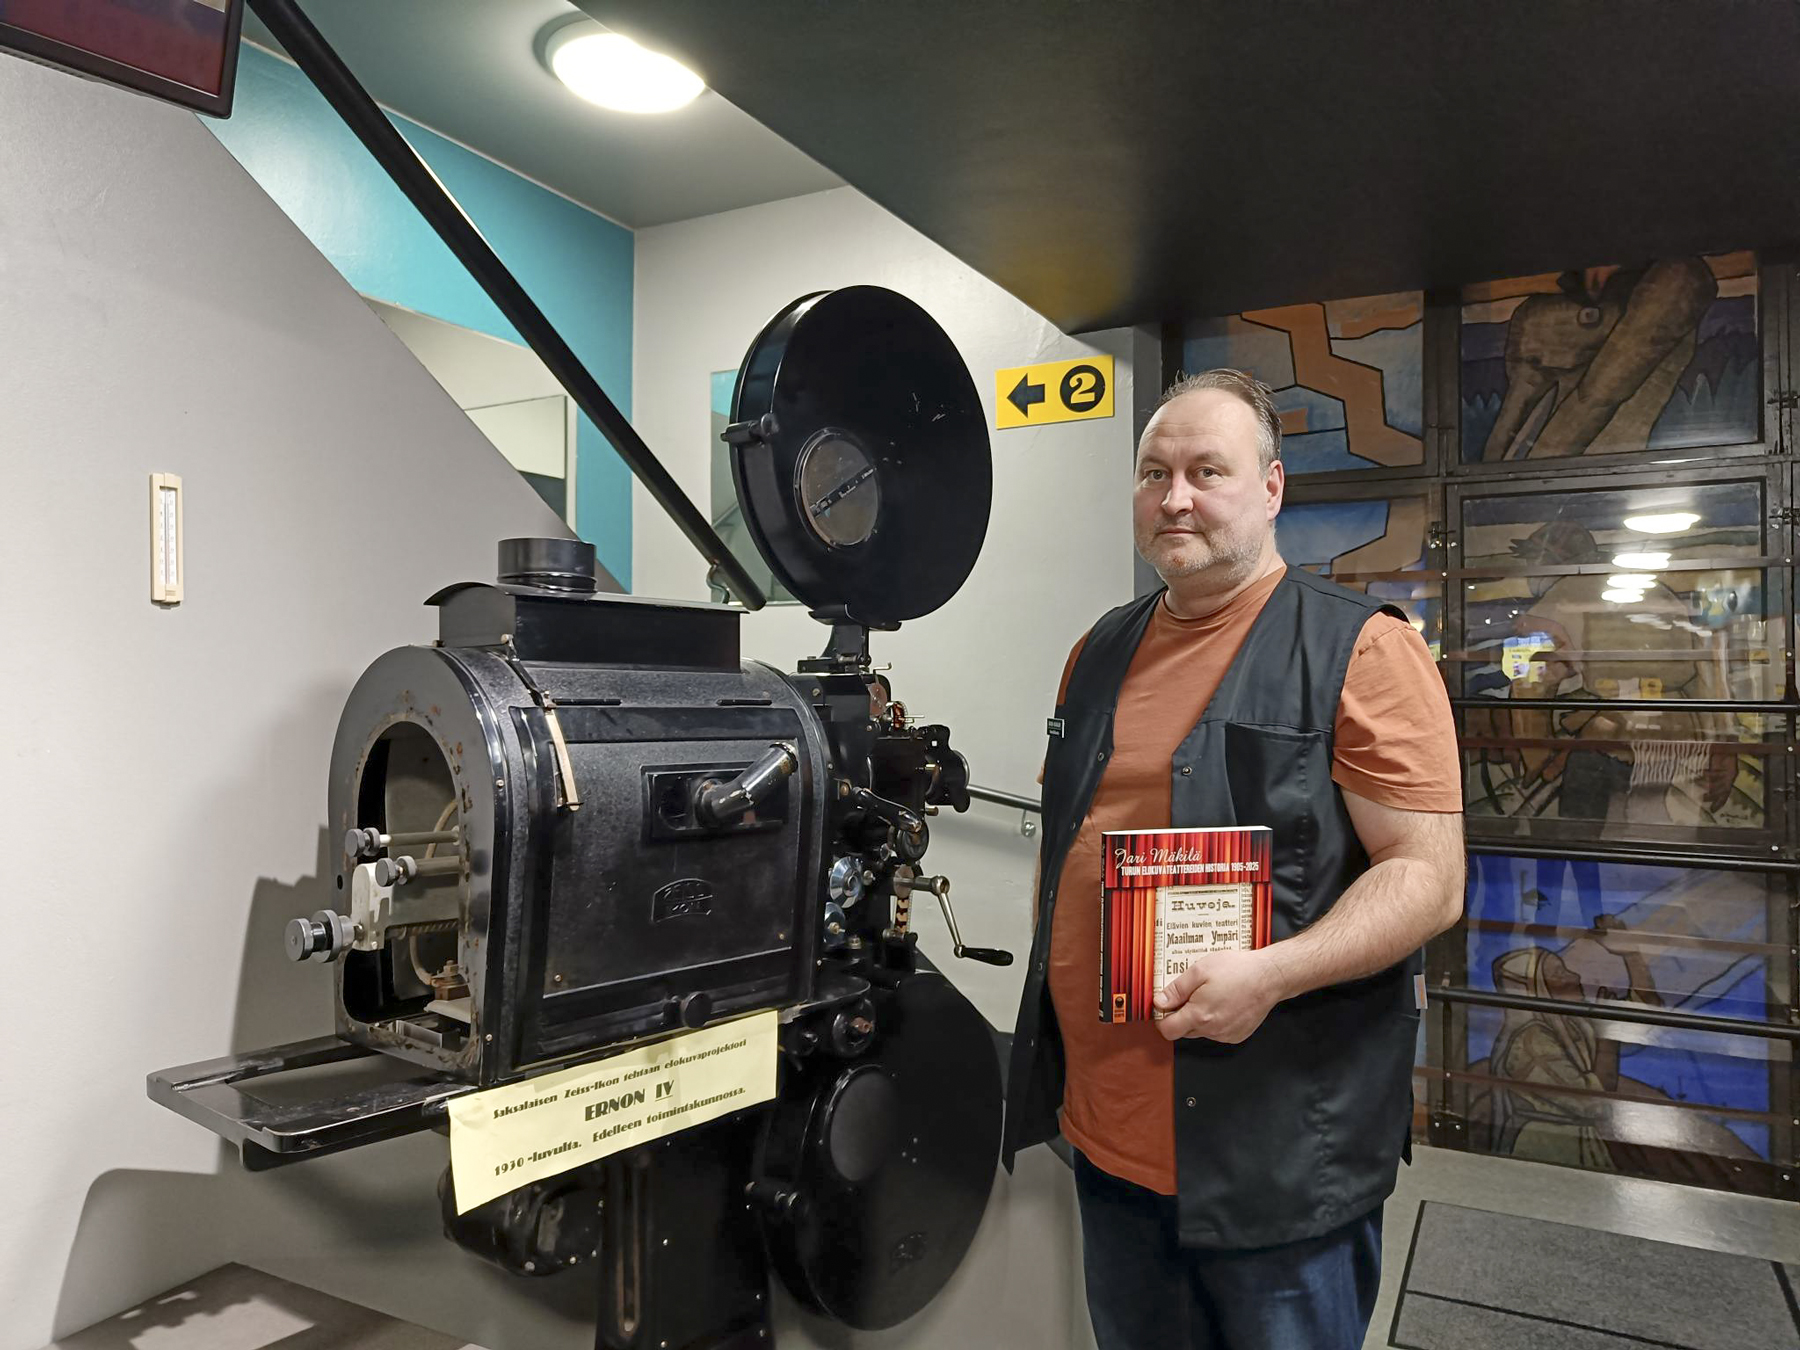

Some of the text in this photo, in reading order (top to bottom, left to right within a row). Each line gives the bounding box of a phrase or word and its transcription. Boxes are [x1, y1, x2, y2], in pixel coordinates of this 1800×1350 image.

[1069, 372, 1096, 404] 2
[1115, 846, 1202, 869] Jari Mäkilä
[1121, 866, 1141, 876] TURUN
[1205, 862, 1230, 873] HISTORIA
[1231, 862, 1259, 872] 1905-2025
[1166, 921, 1189, 930] Elävien
[1215, 919, 1238, 928] teatteri
[1166, 930, 1239, 948] Maailman Ympäri
[493, 1039, 747, 1119] Saksalaisen Zeiss-Ikon tehtaan elokuvaprojektori
[584, 1080, 675, 1121] ERNON IV
[494, 1157, 525, 1176] 1930
[592, 1119, 642, 1143] Edelleen
[646, 1087, 746, 1124] toimintakunnossa.
